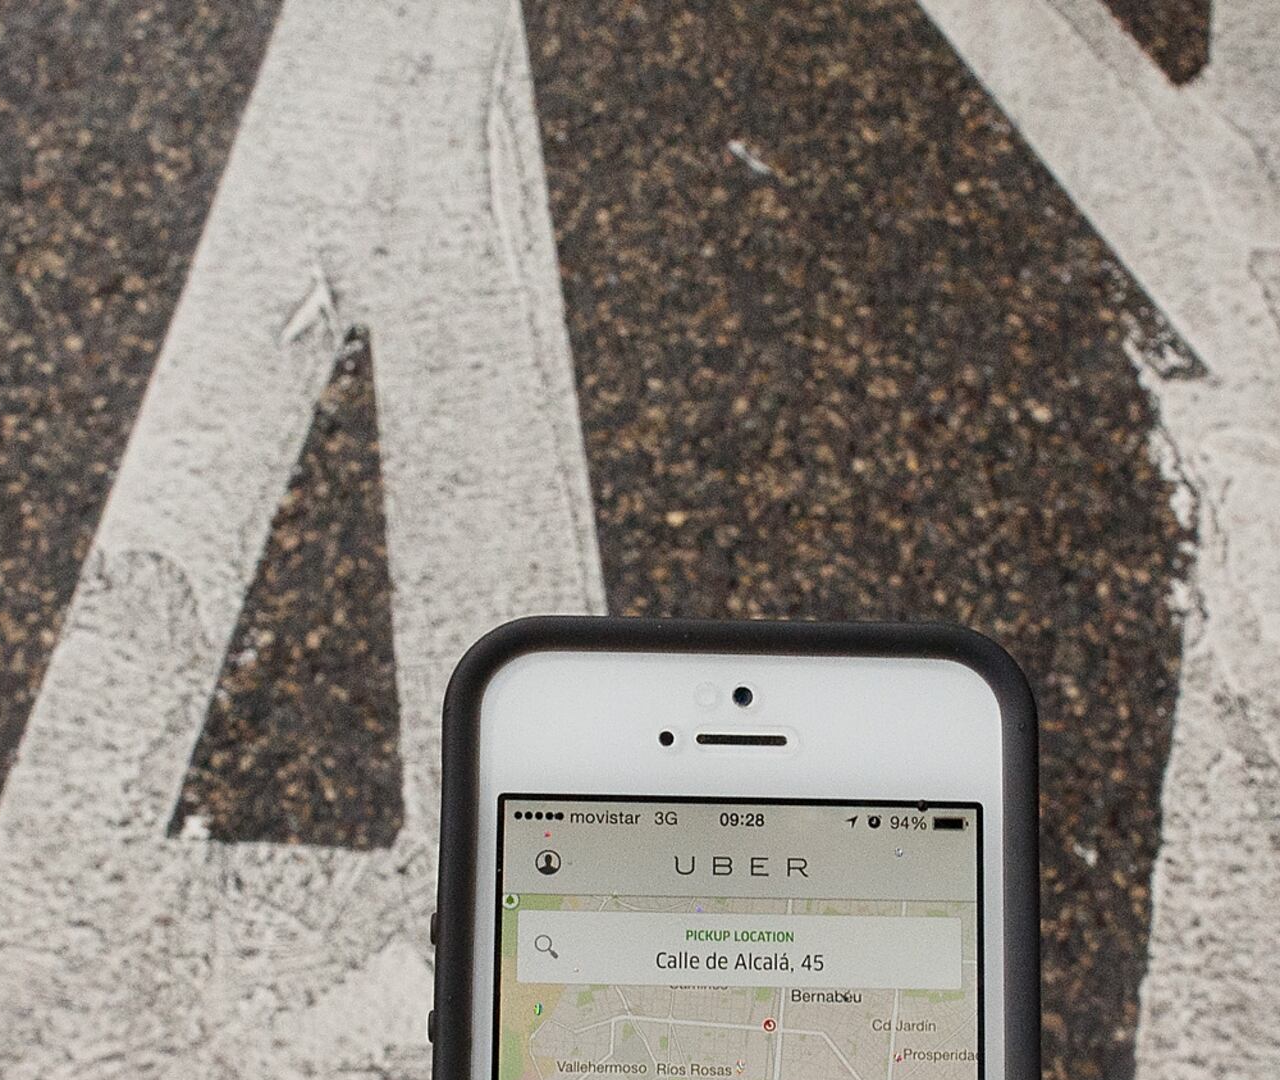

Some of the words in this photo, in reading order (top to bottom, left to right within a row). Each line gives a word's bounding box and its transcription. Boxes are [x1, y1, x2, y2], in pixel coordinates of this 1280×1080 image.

[570, 811, 641, 826] movistar
[654, 811, 678, 826] 3G
[719, 812, 765, 828] 09:28
[889, 816, 928, 831] 94%
[673, 855, 809, 878] UBER
[685, 929, 731, 943] PICKUP
[734, 930, 795, 944] LOCATION
[655, 951, 701, 971] Calle
[705, 952, 729, 971] de
[734, 952, 796, 975] Alcalá,
[800, 954, 825, 973] 45
[791, 988, 862, 1004] Bernabéu
[872, 1019, 892, 1032] Cd
[895, 1018, 937, 1033] Jardín
[557, 1060, 648, 1076] Vallehermoso
[656, 1062, 687, 1077] Ríos
[690, 1063, 733, 1078] Rosas
